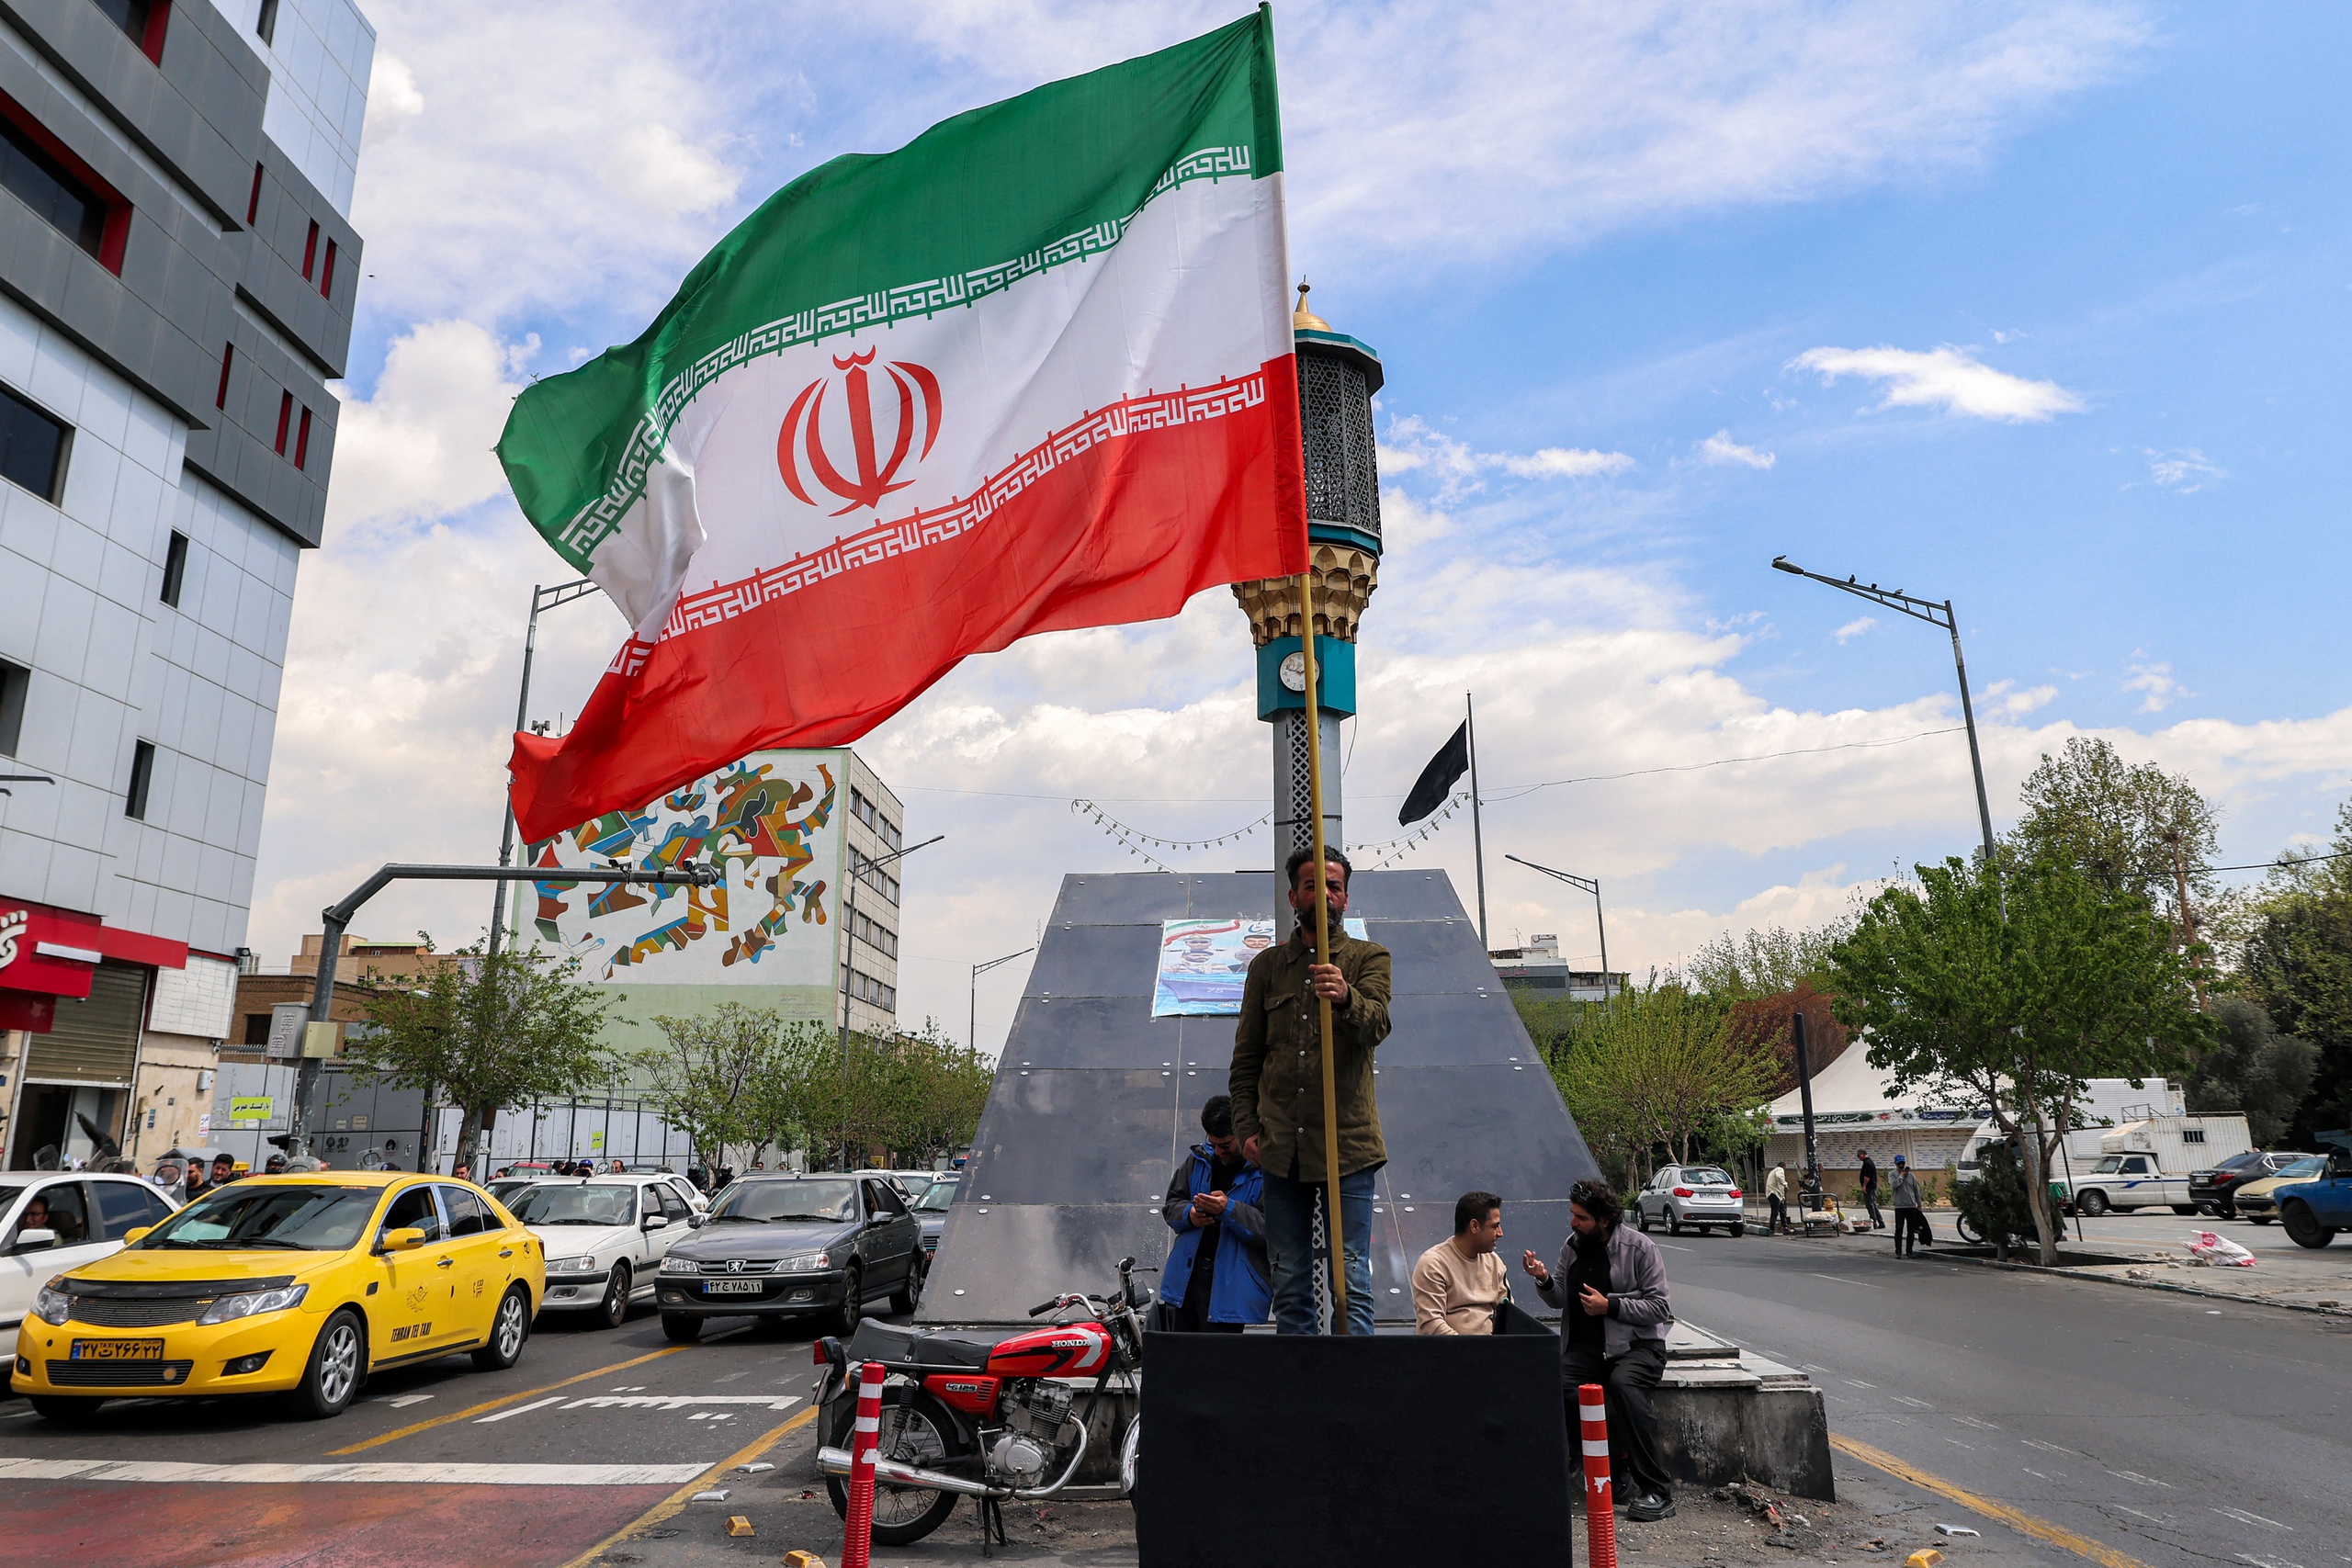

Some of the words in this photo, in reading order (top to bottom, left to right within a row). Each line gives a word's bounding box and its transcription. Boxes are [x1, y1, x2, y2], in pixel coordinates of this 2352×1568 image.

[731, 1281, 749, 1292] ۷۸۵
[751, 1283, 761, 1292] ۱۱
[390, 1325, 412, 1343] TEHRAN
[411, 1324, 420, 1338] TEL
[420, 1322, 432, 1337] TAXI
[98, 1348, 113, 1358] ت
[115, 1343, 141, 1358] ۲۶۶
[1052, 1338, 1091, 1348] HONDA
[471, 1386, 803, 1421] ایست
